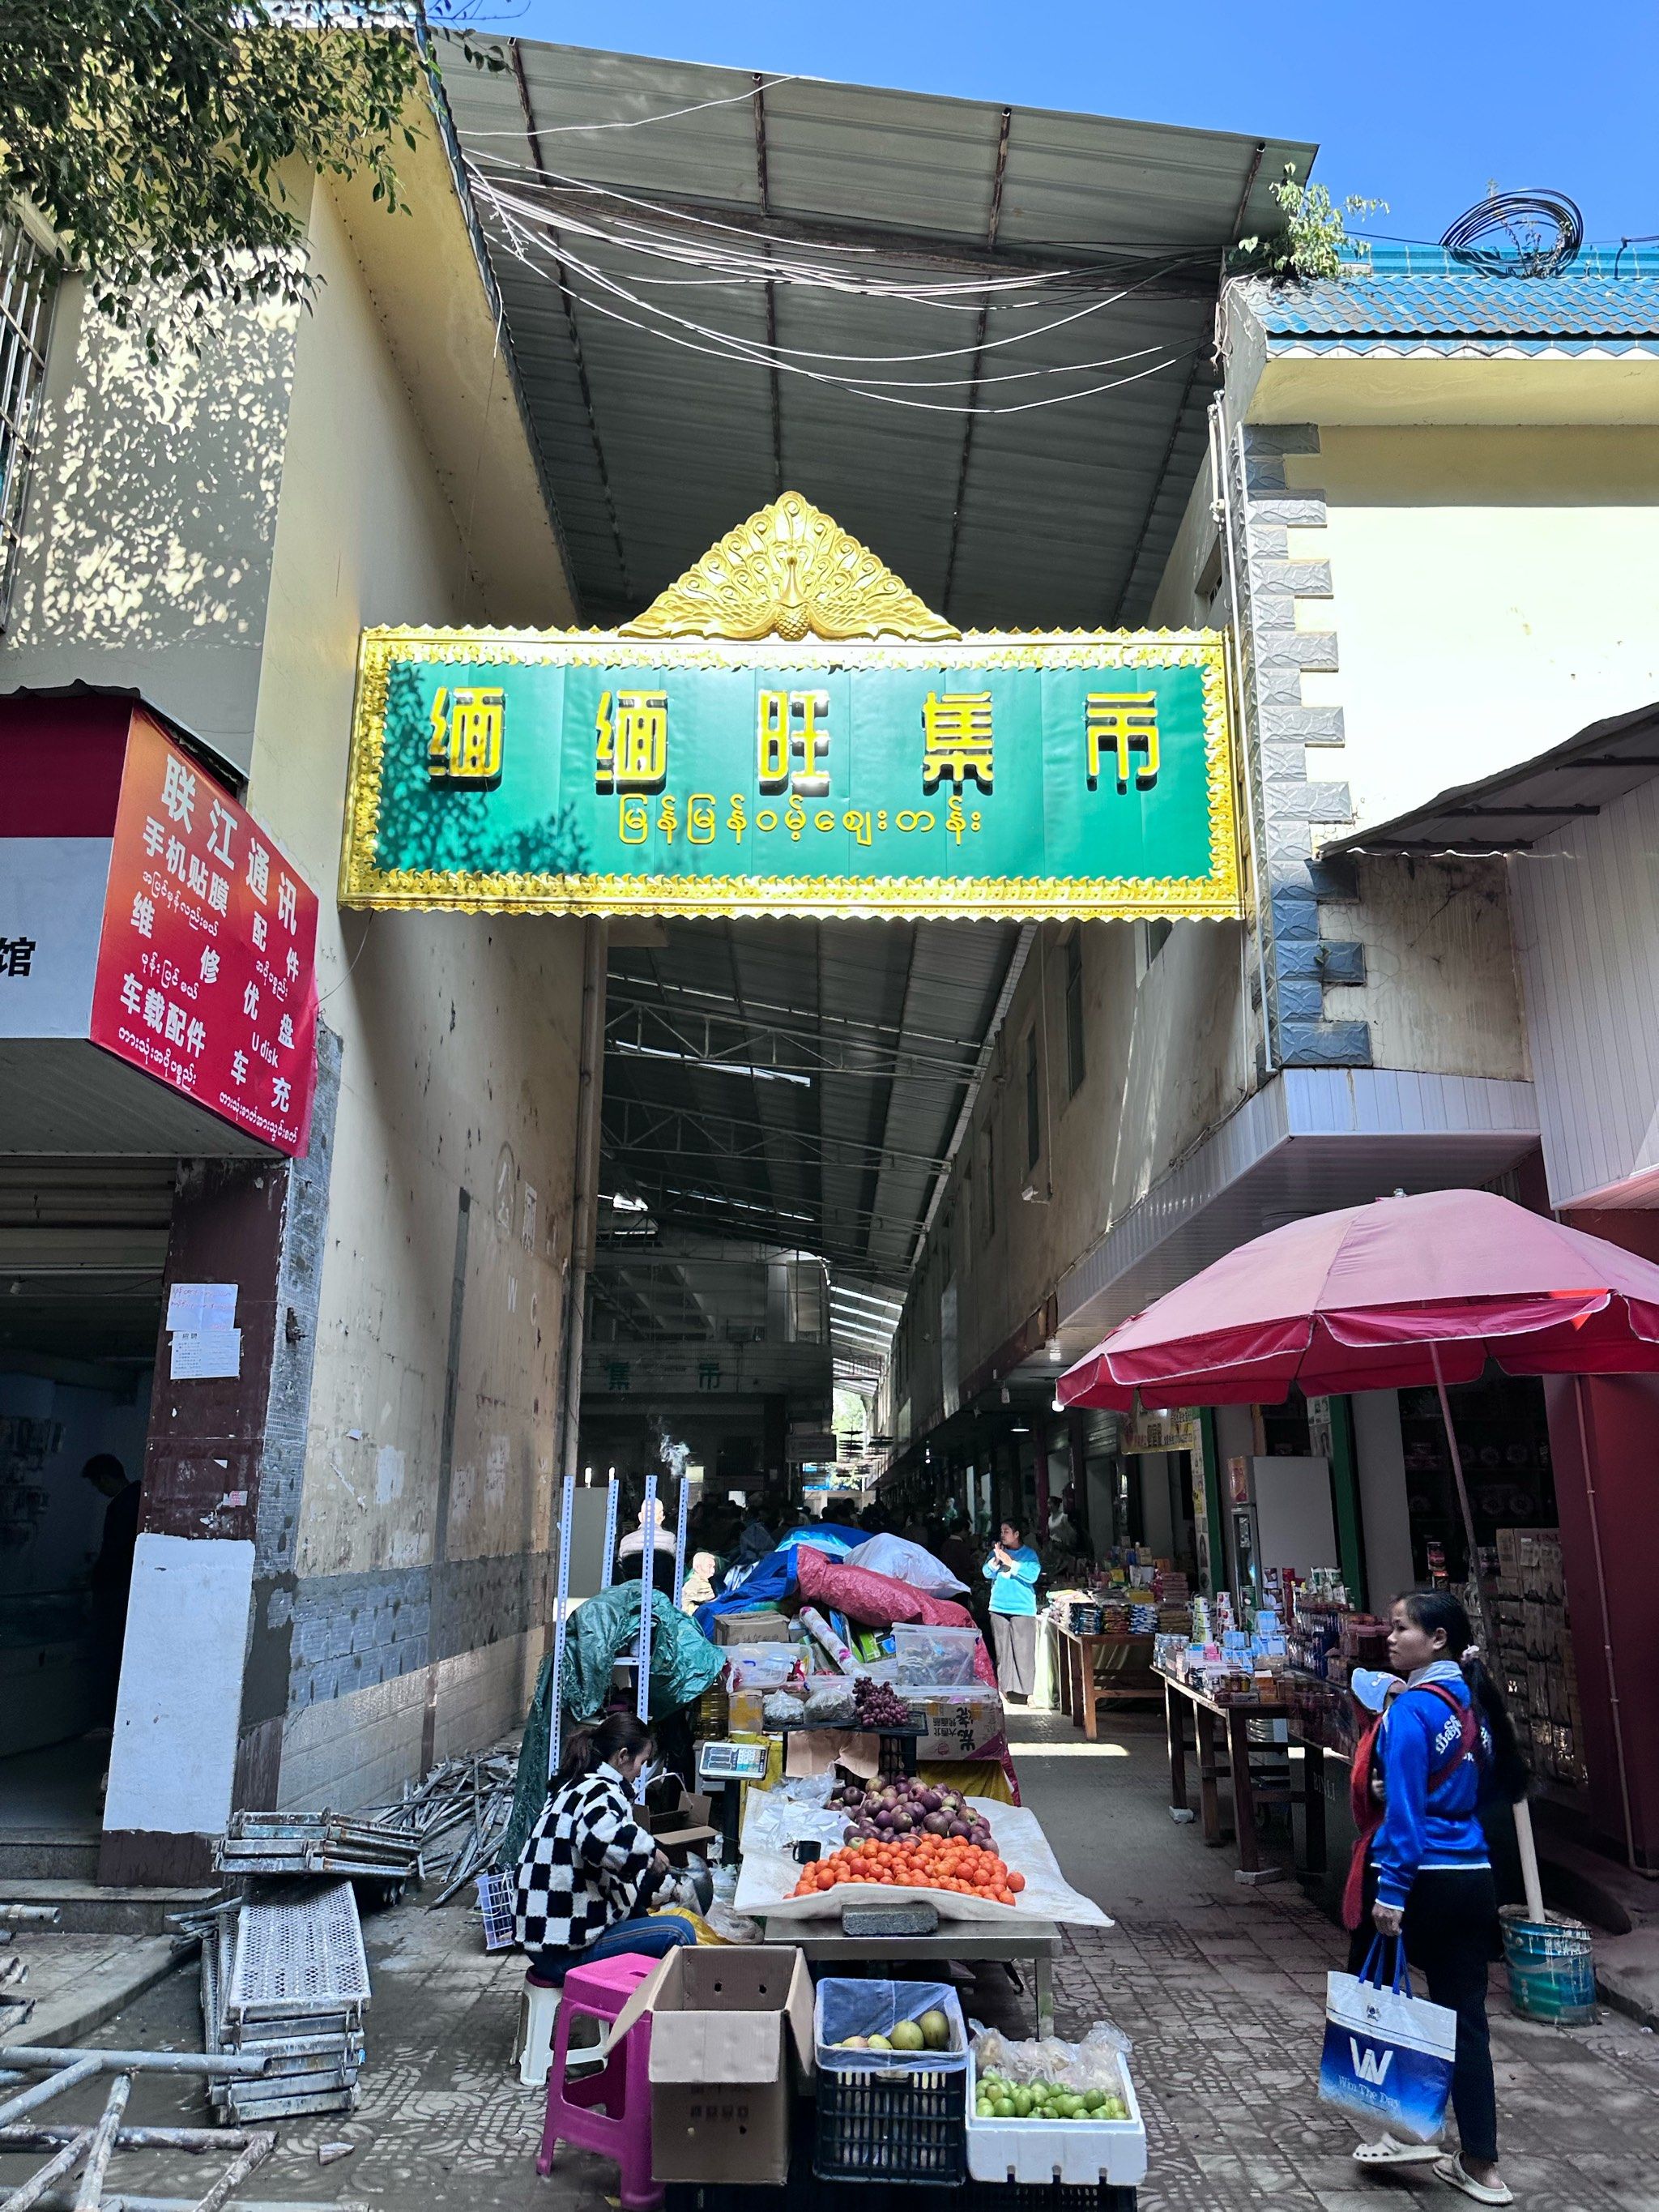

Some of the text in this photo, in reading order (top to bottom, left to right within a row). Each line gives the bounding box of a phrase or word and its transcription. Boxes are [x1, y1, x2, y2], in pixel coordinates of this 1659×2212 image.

[429, 685, 1160, 786] 缅缅旺集市
[143, 815, 230, 918] 手机贴膜
[160, 754, 298, 937] 联江通讯
[0, 936, 36, 977] 馆
[130, 890, 221, 984] 维修
[251, 910, 301, 984] 配件
[119, 971, 207, 1059] 车载配件
[242, 980, 296, 1051] 优盘
[251, 1031, 279, 1069] U disk
[229, 1048, 292, 1113] 车充
[932, 1727, 957, 1737] 大西北
[1338, 2074, 1357, 2092] Win
[1358, 2082, 1377, 2100] The
